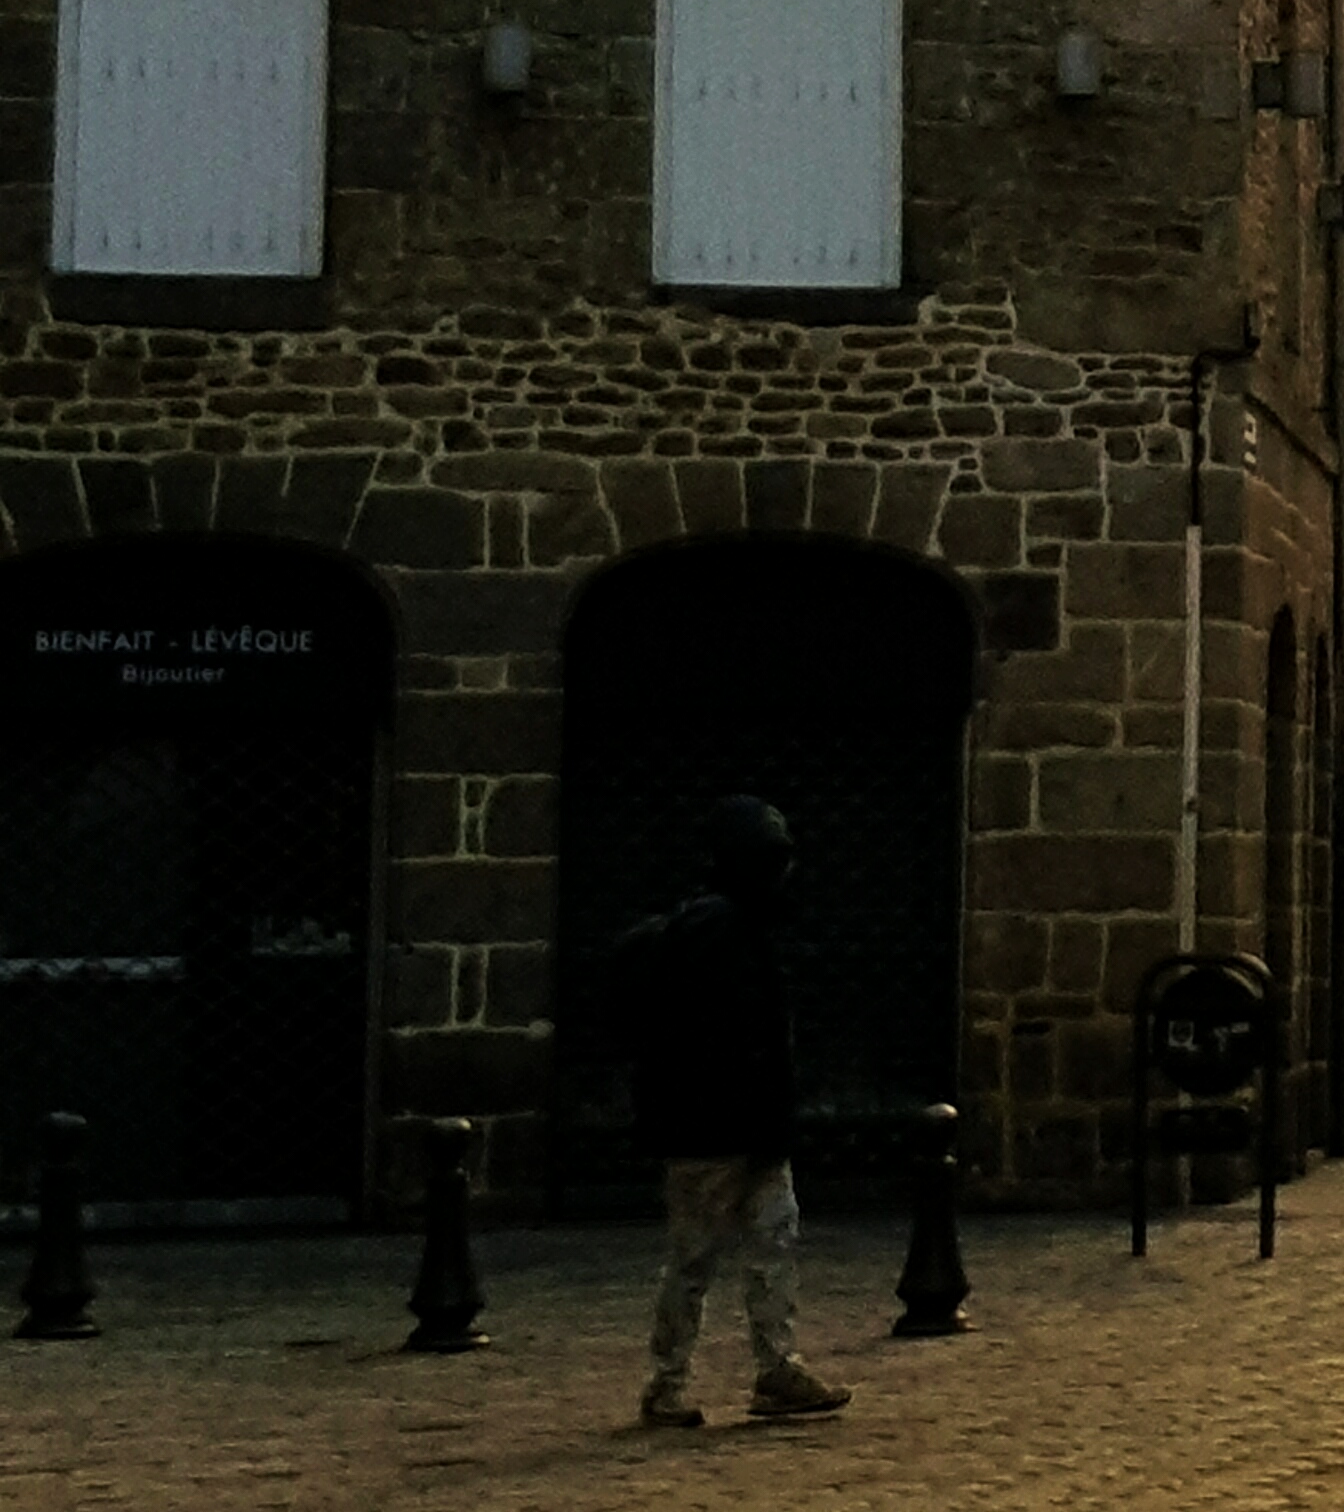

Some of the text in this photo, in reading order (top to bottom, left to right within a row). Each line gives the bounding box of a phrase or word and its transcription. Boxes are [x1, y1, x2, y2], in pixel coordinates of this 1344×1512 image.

[34, 629, 155, 653] BIENFAIT
[191, 624, 313, 653] LÉVÊQUE
[122, 663, 226, 685] Bijoutier
